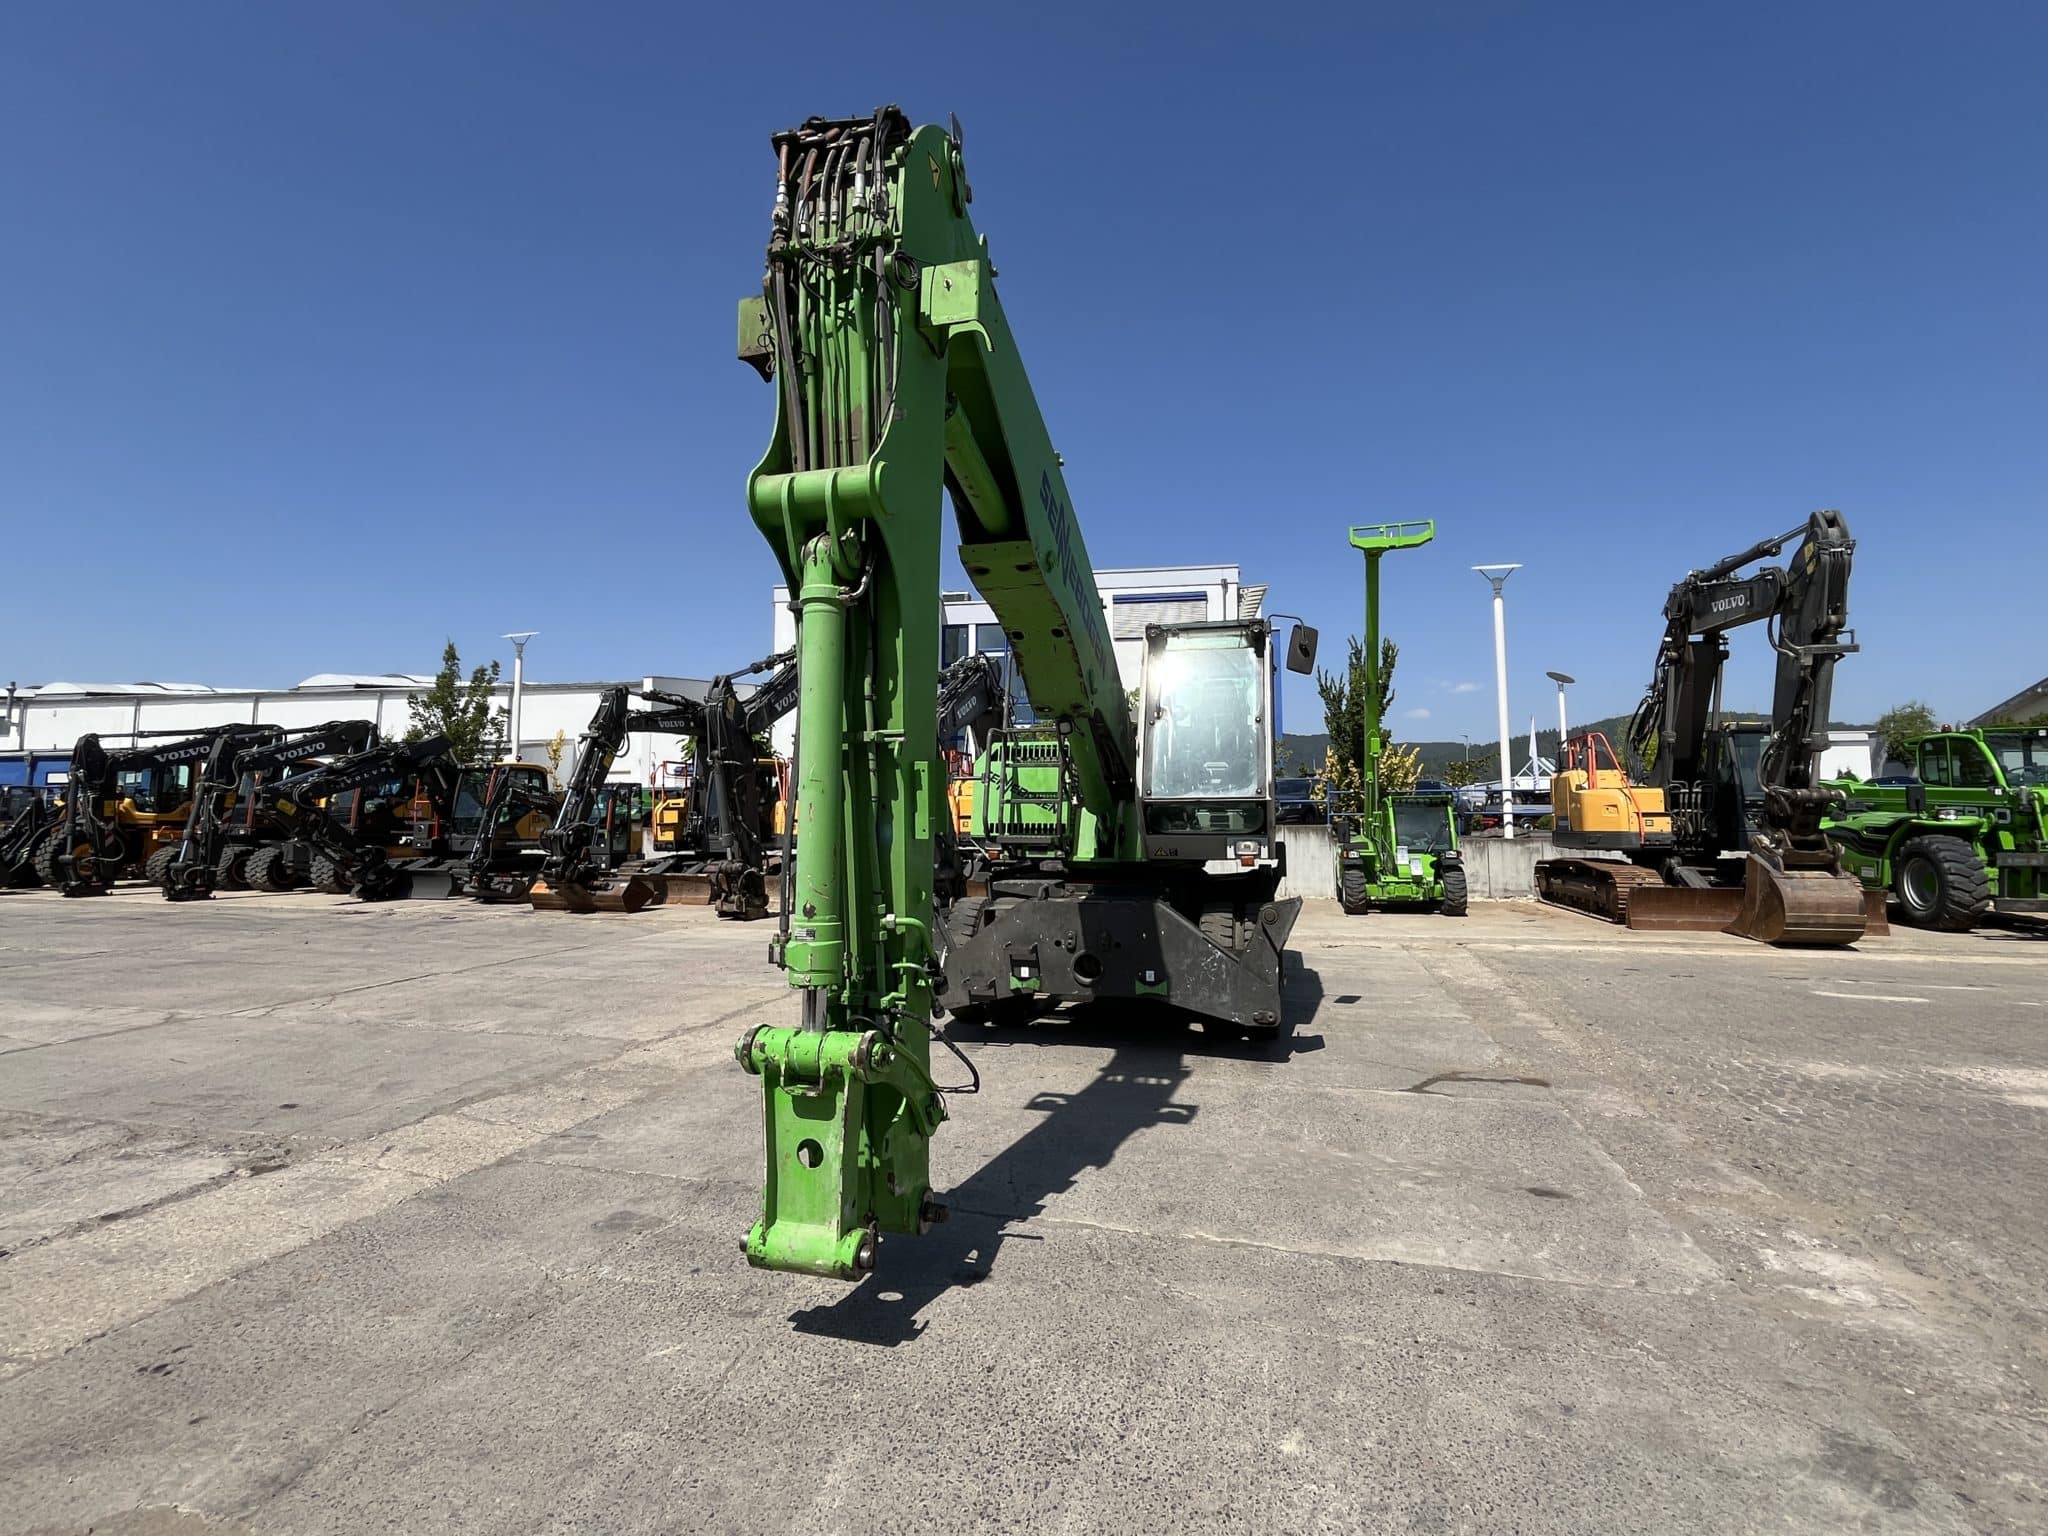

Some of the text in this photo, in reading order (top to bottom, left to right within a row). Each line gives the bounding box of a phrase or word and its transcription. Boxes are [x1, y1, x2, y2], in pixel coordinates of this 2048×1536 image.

[1712, 594, 1745, 613] VOLVO
[774, 687, 799, 712] VOLV
[658, 720, 685, 728] VOLVO
[154, 745, 210, 762] VOLVO
[274, 742, 326, 761] VOLVO
